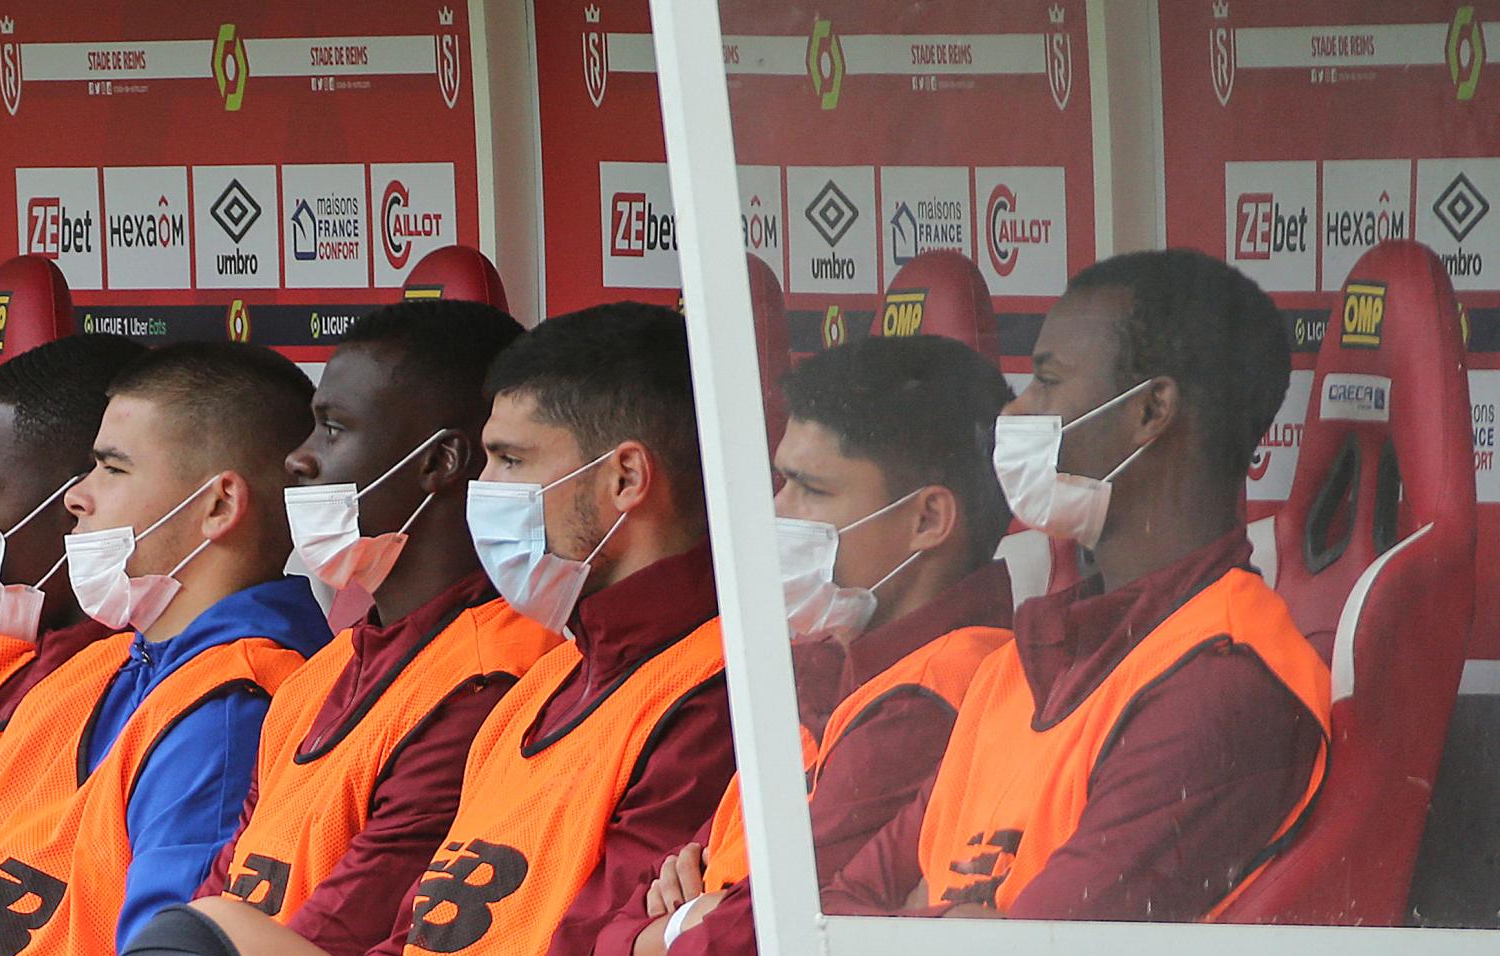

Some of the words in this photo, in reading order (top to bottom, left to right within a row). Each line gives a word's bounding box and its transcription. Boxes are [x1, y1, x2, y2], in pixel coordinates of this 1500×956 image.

[910, 45, 936, 65] STADE
[936, 45, 947, 65] DE
[948, 44, 972, 65] REIMS
[1311, 36, 1336, 56] STADE
[1338, 35, 1348, 56] DE
[1350, 34, 1374, 56] REIMS
[88, 52, 111, 70] STADE
[112, 51, 122, 70] DE
[123, 50, 146, 70] REIMS
[310, 46, 333, 66] STADE
[334, 46, 344, 65] DE
[346, 46, 368, 65] REIMS
[316, 196, 359, 216] maisons
[918, 198, 962, 220] maisons
[28, 197, 92, 260] ZEbet
[318, 220, 360, 237] FRANCE
[919, 224, 962, 243] FRANCE
[1235, 193, 1308, 260] ZEbet
[216, 248, 258, 275] umbro
[318, 242, 360, 260] CONFORT
[812, 252, 856, 280] umbro
[95, 317, 122, 334] LIGUE
[130, 316, 148, 334] Uber
[148, 318, 166, 334] Eats
[884, 303, 922, 337] OMP
[1344, 294, 1382, 335] OMP
